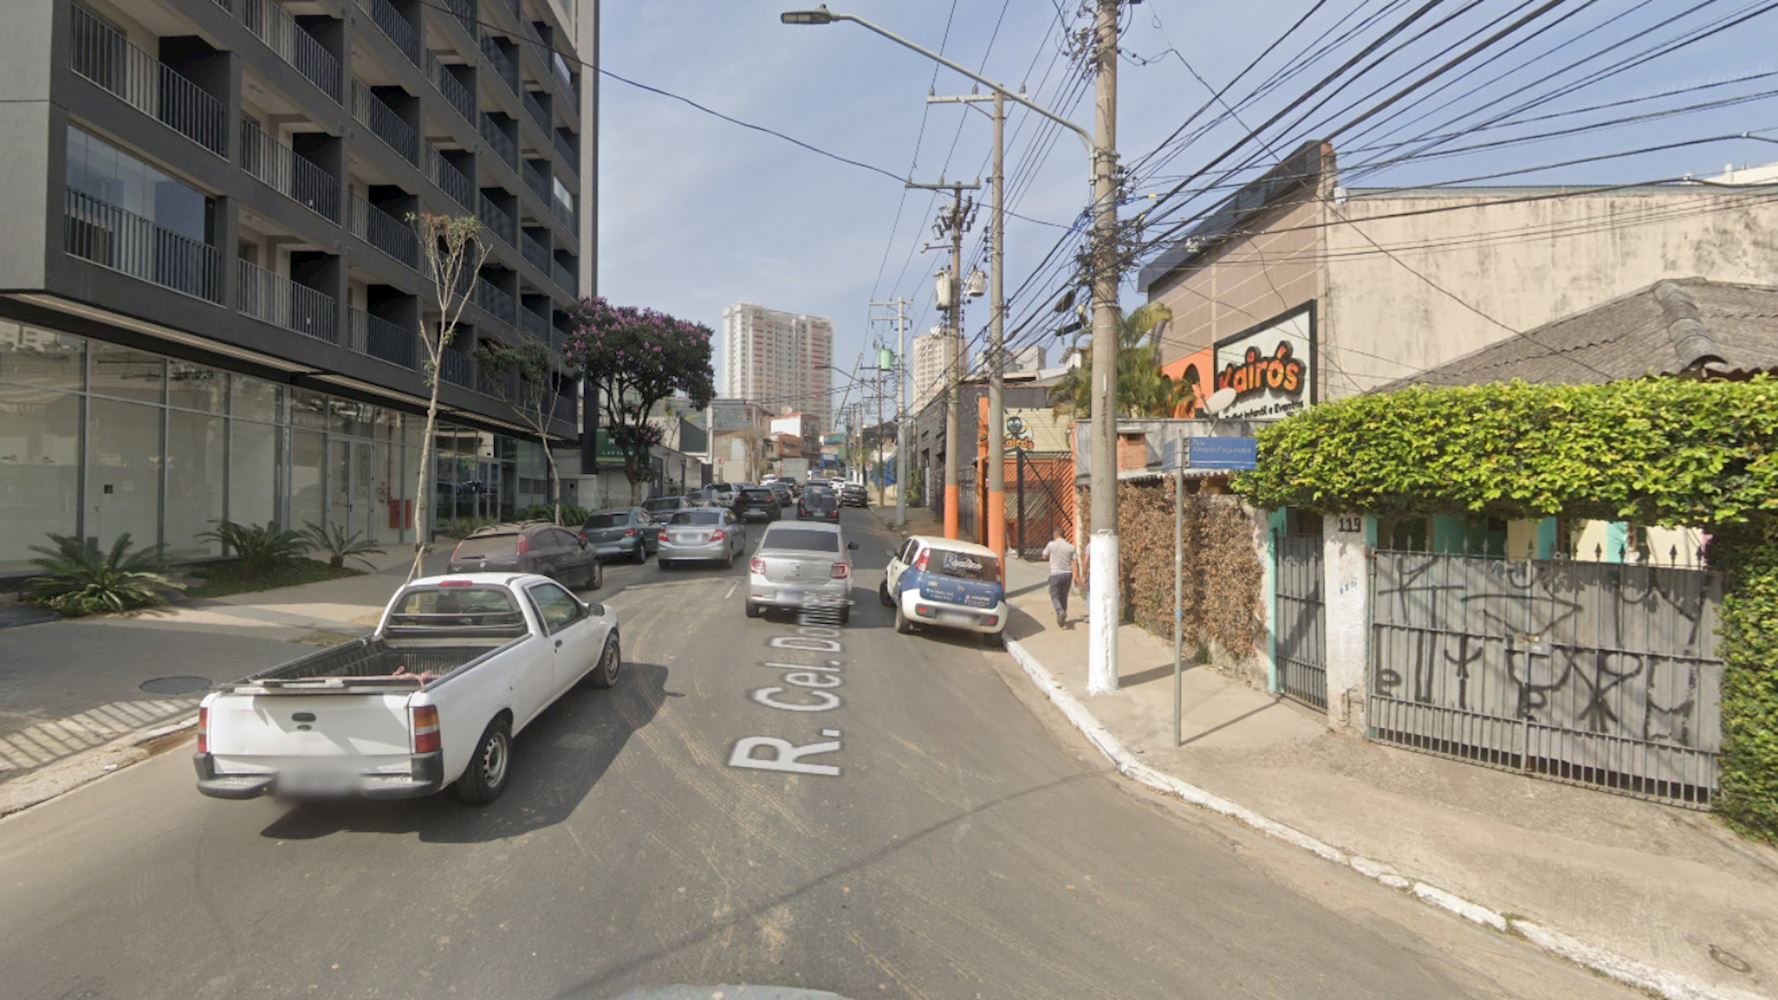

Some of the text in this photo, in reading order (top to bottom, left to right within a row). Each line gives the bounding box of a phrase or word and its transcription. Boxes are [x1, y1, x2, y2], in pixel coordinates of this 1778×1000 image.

[1274, 400, 1304, 414] Eventos
[1003, 436, 1035, 450] airós
[1338, 516, 1362, 532] 119
